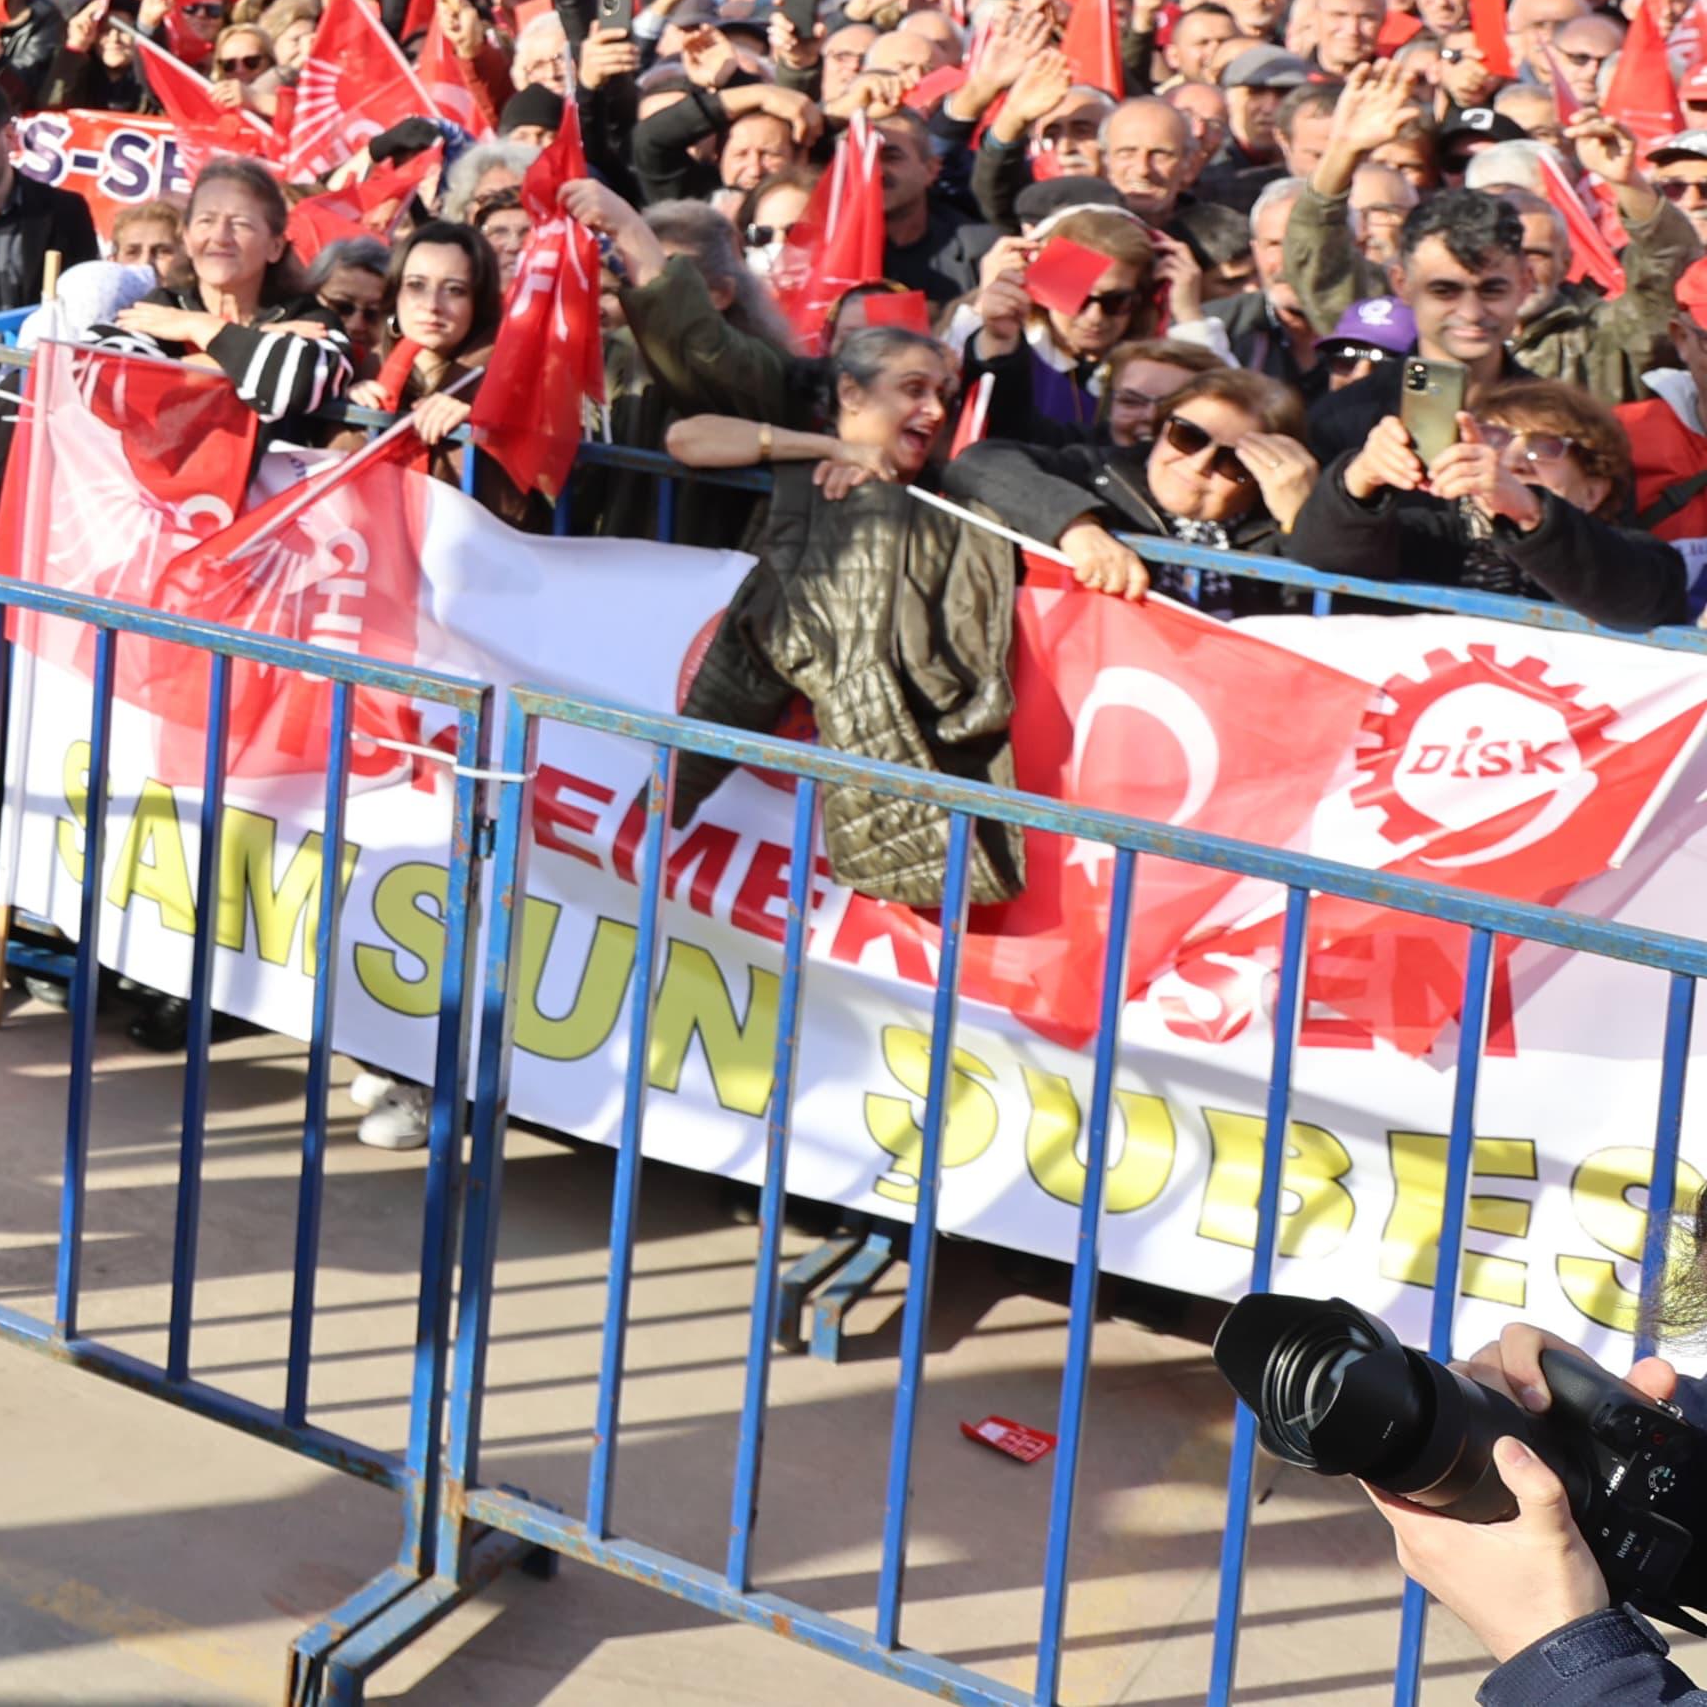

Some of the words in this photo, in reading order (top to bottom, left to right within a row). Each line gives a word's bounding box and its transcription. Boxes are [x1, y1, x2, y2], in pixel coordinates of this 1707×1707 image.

[1407, 725, 1570, 779] DİSK
[55, 739, 783, 1119] SAMSUN
[1605, 1464, 1627, 1498] SONY
